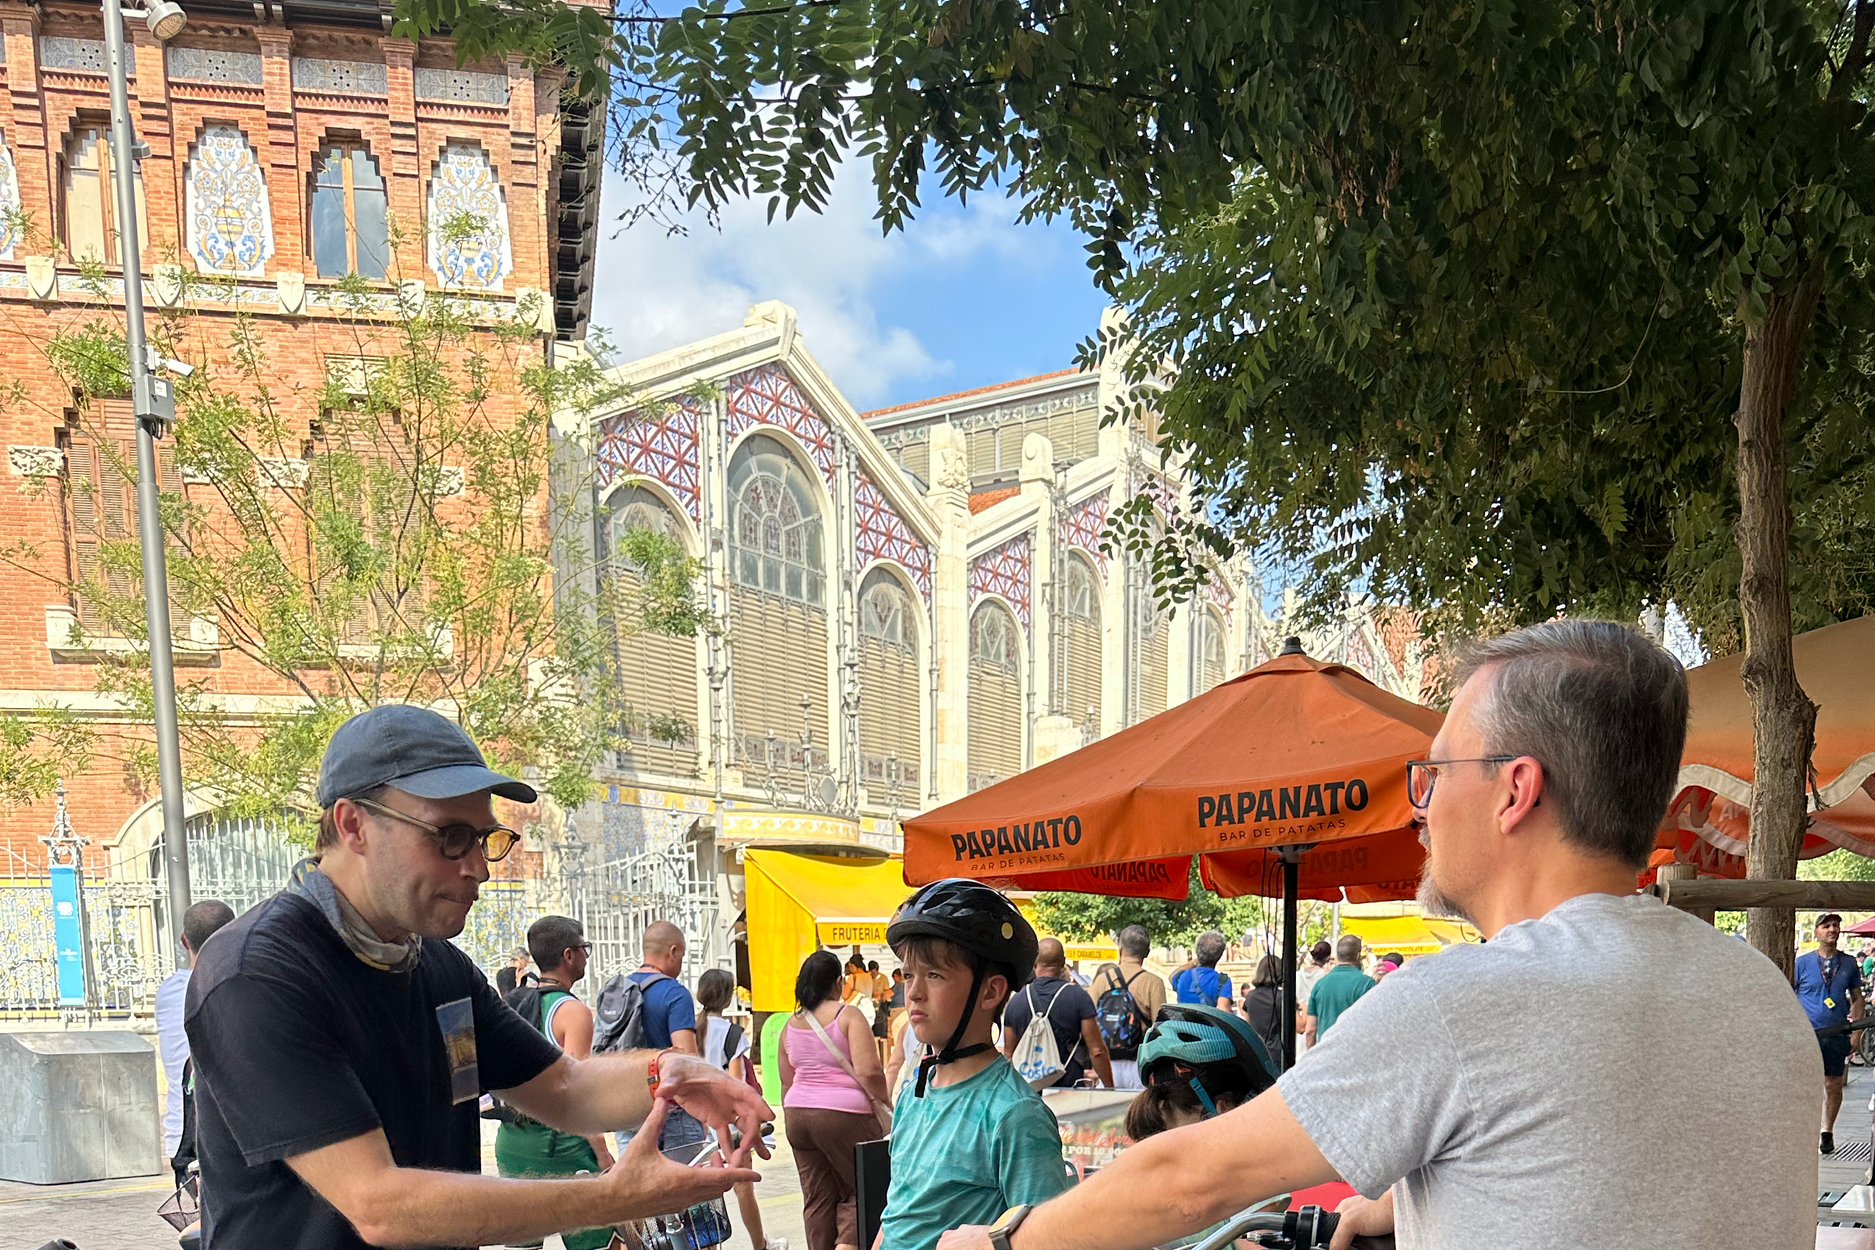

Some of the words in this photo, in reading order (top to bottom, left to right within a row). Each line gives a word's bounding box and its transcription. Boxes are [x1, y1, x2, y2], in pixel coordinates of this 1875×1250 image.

[1197, 778, 1369, 828] PAPANATO
[951, 815, 1082, 862] PAPANATO
[1219, 832, 1247, 842] BAR
[1253, 827, 1271, 838] DE
[1278, 819, 1346, 836] PATATAS
[971, 862, 995, 871] BAR
[1000, 858, 1014, 869] DE
[1018, 852, 1066, 866] PATATAS
[832, 927, 881, 941] FRUTERIA
[1068, 1145, 1092, 1156] POR
